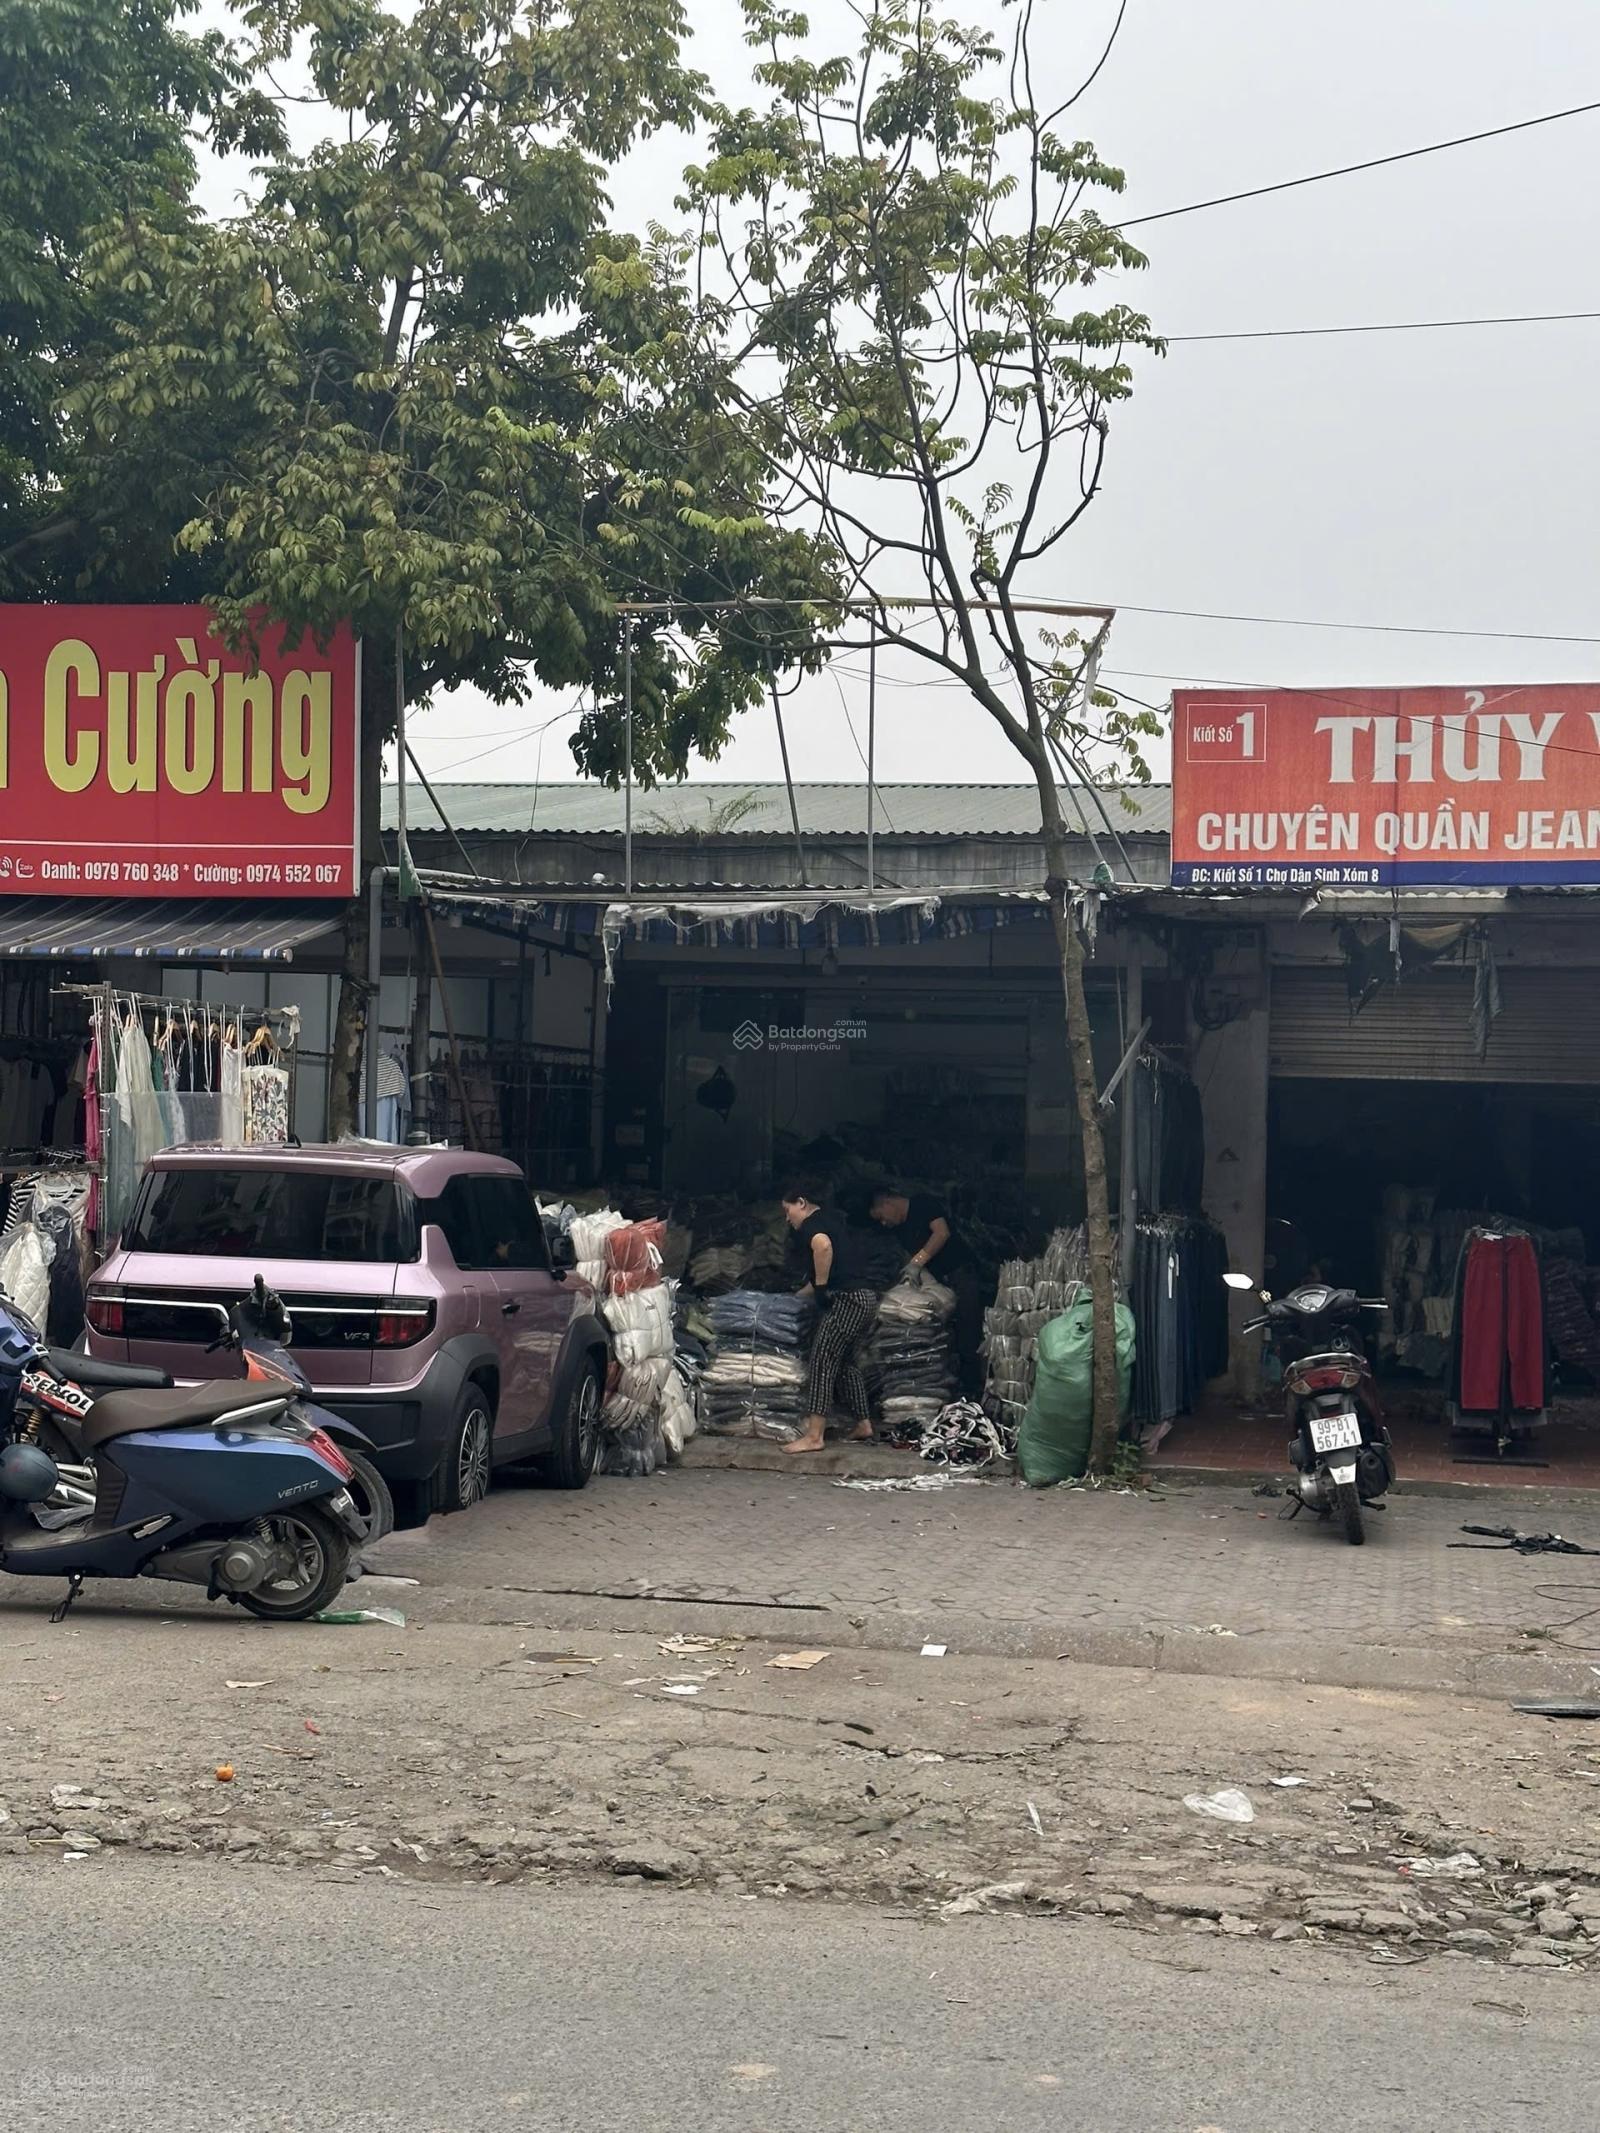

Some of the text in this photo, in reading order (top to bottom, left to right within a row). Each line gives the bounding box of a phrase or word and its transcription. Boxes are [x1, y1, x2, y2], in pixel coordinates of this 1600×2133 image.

[44, 637, 332, 815] Cường
[1193, 711, 1254, 757] Kiốt Số 1
[1314, 690, 1566, 784] THỦY
[1197, 803, 1360, 852] CHUYÊN
[1374, 798, 1490, 856] QUẦN
[41, 860, 342, 885] Oanh: 0979 760 348 Cường: 0974 552 067
[1191, 866, 1379, 885] ĐC: Kiốt Số 1 Chợ Dân Sinh Xóm 8
[1317, 1417, 1350, 1435] 99-B1
[1316, 1430, 1358, 1450] 567.41
[278, 1479, 319, 1499] VENTO
